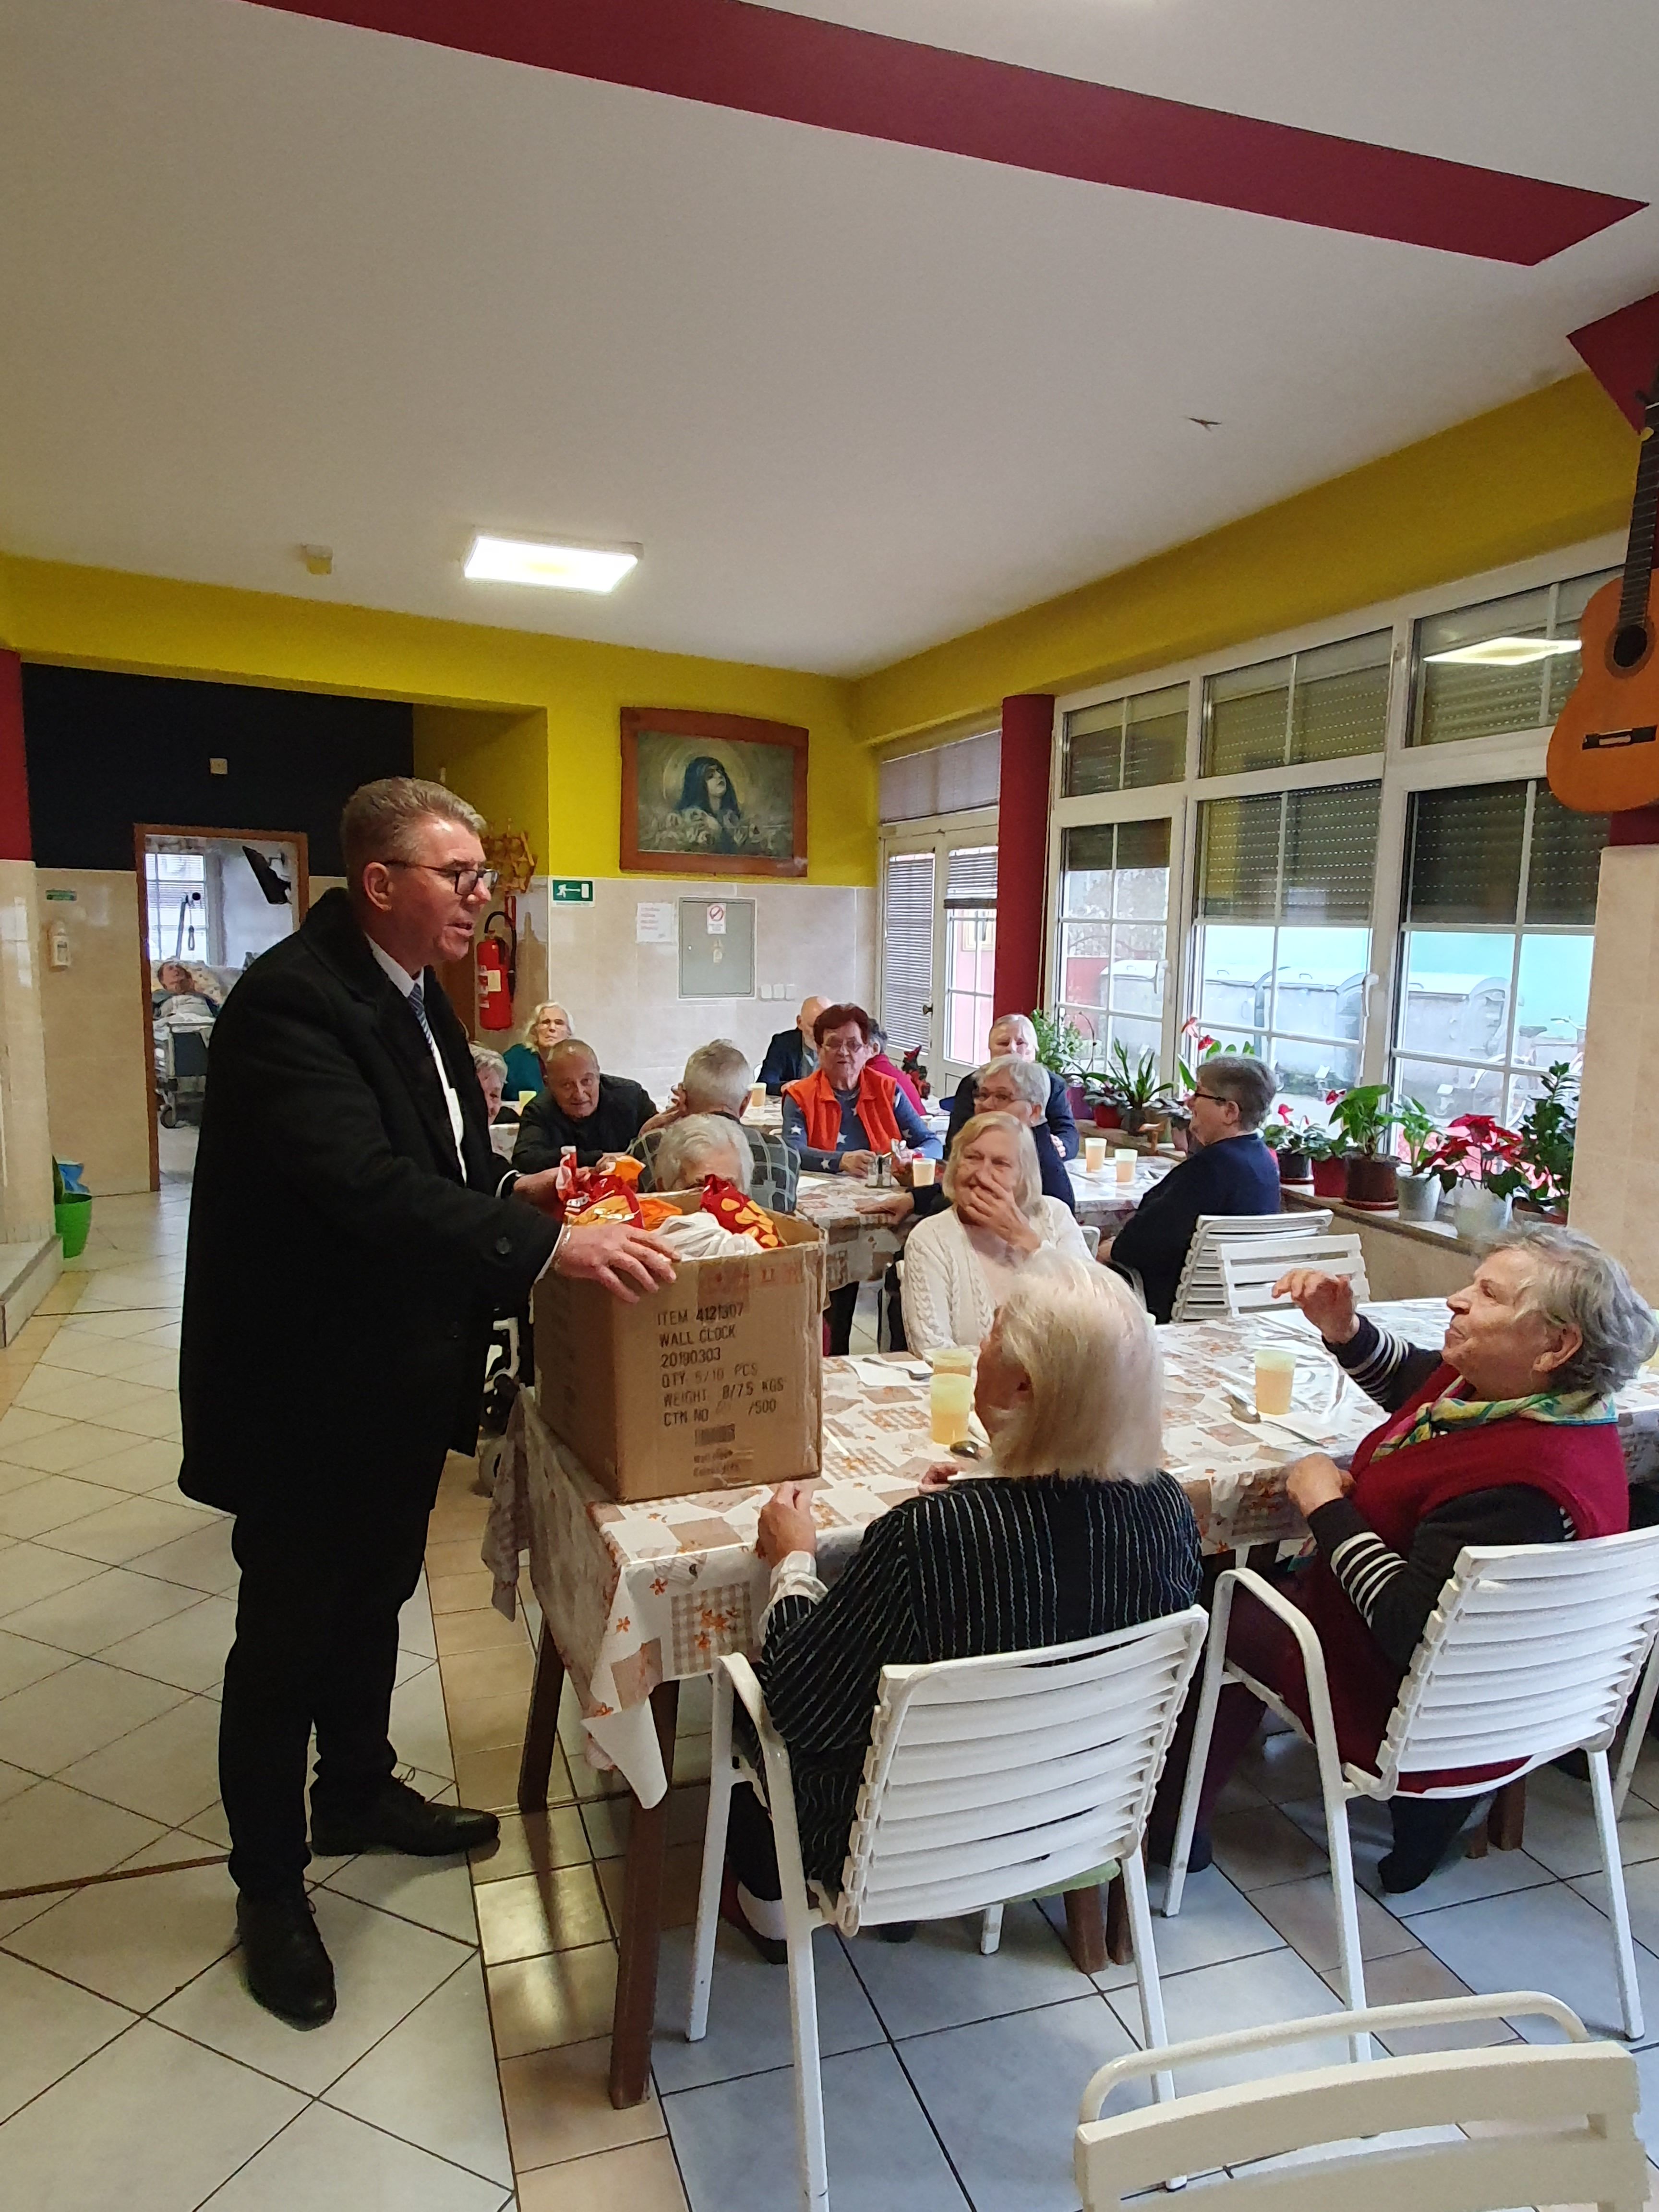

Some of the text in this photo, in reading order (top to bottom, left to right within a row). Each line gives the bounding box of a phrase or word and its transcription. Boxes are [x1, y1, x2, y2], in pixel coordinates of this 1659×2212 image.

[658, 1309, 688, 1325] ITEM
[660, 1324, 735, 1348] WALL CLOCK
[734, 1363, 757, 1377] PCS
[664, 1389, 707, 1407] WEIGHT
[762, 1378, 784, 1393] KGS
[694, 1408, 709, 1422] NO
